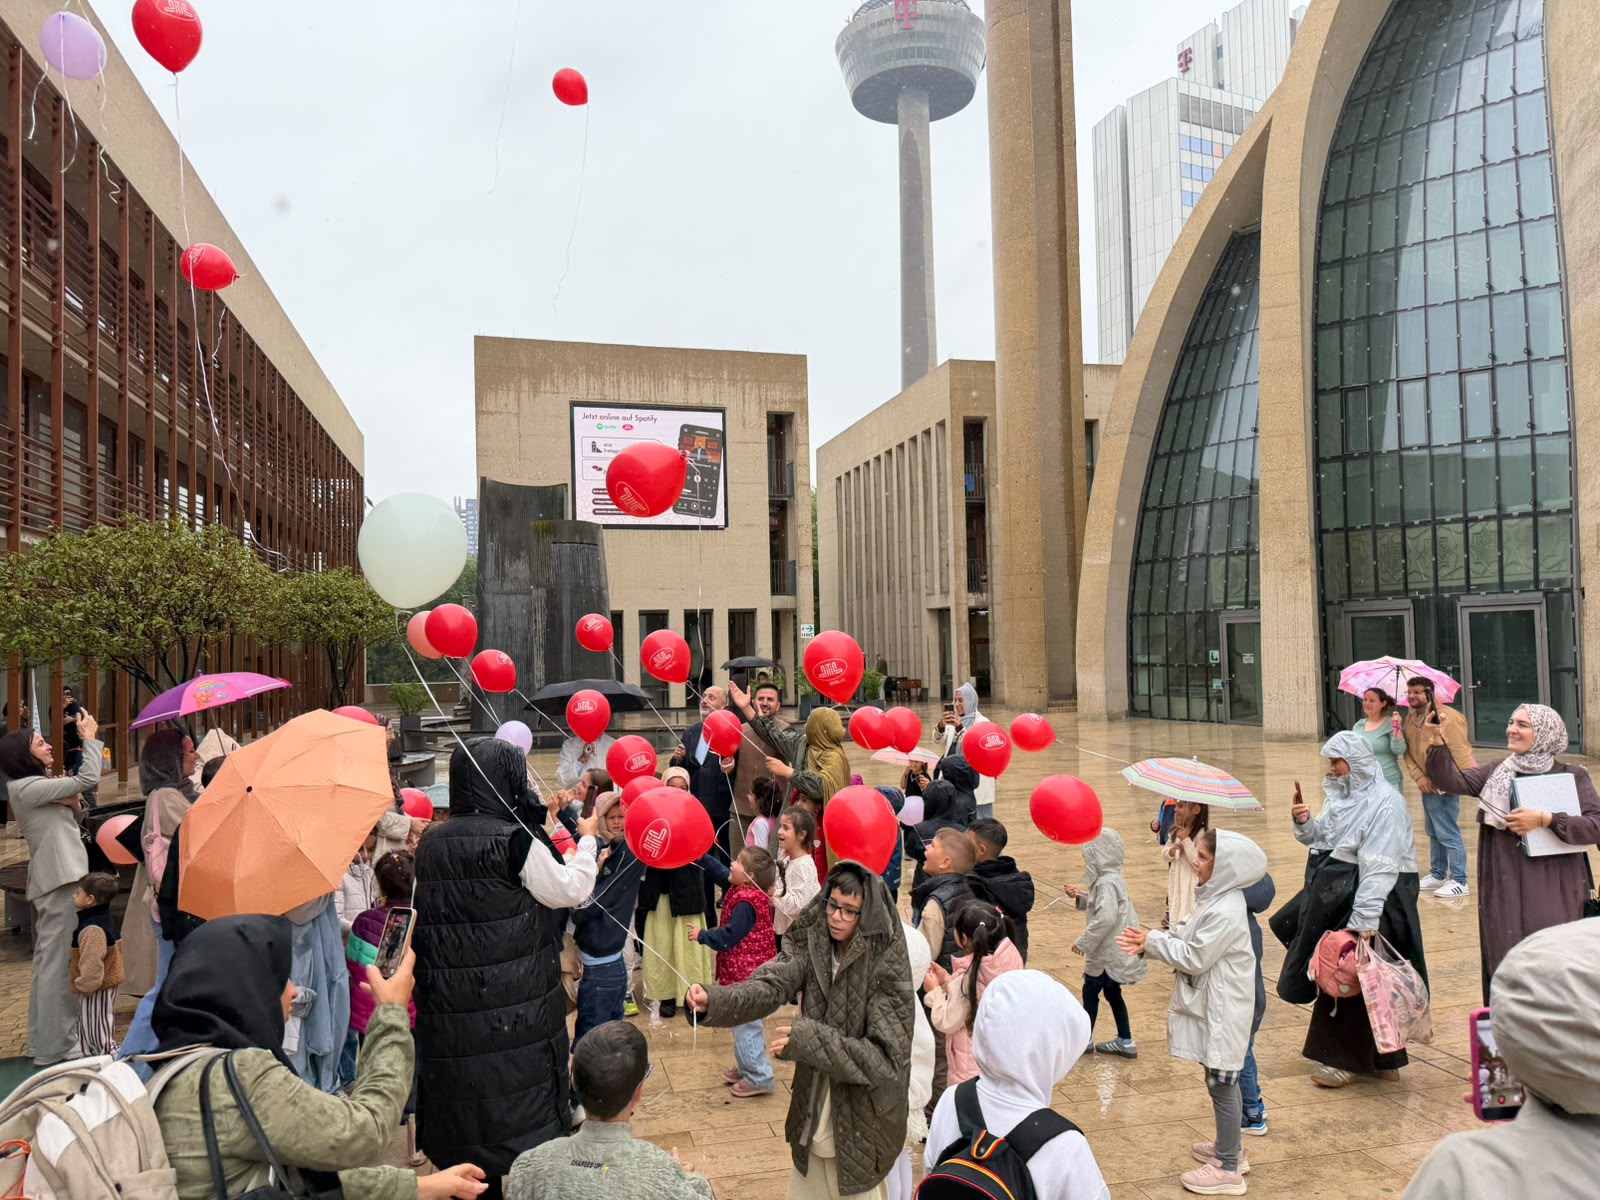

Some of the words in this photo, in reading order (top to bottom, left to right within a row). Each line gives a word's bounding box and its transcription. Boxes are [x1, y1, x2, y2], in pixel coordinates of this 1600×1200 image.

[582, 412, 598, 420] Jetzt
[599, 412, 620, 421] online
[621, 413, 633, 421] auf
[634, 414, 658, 424] Spotify
